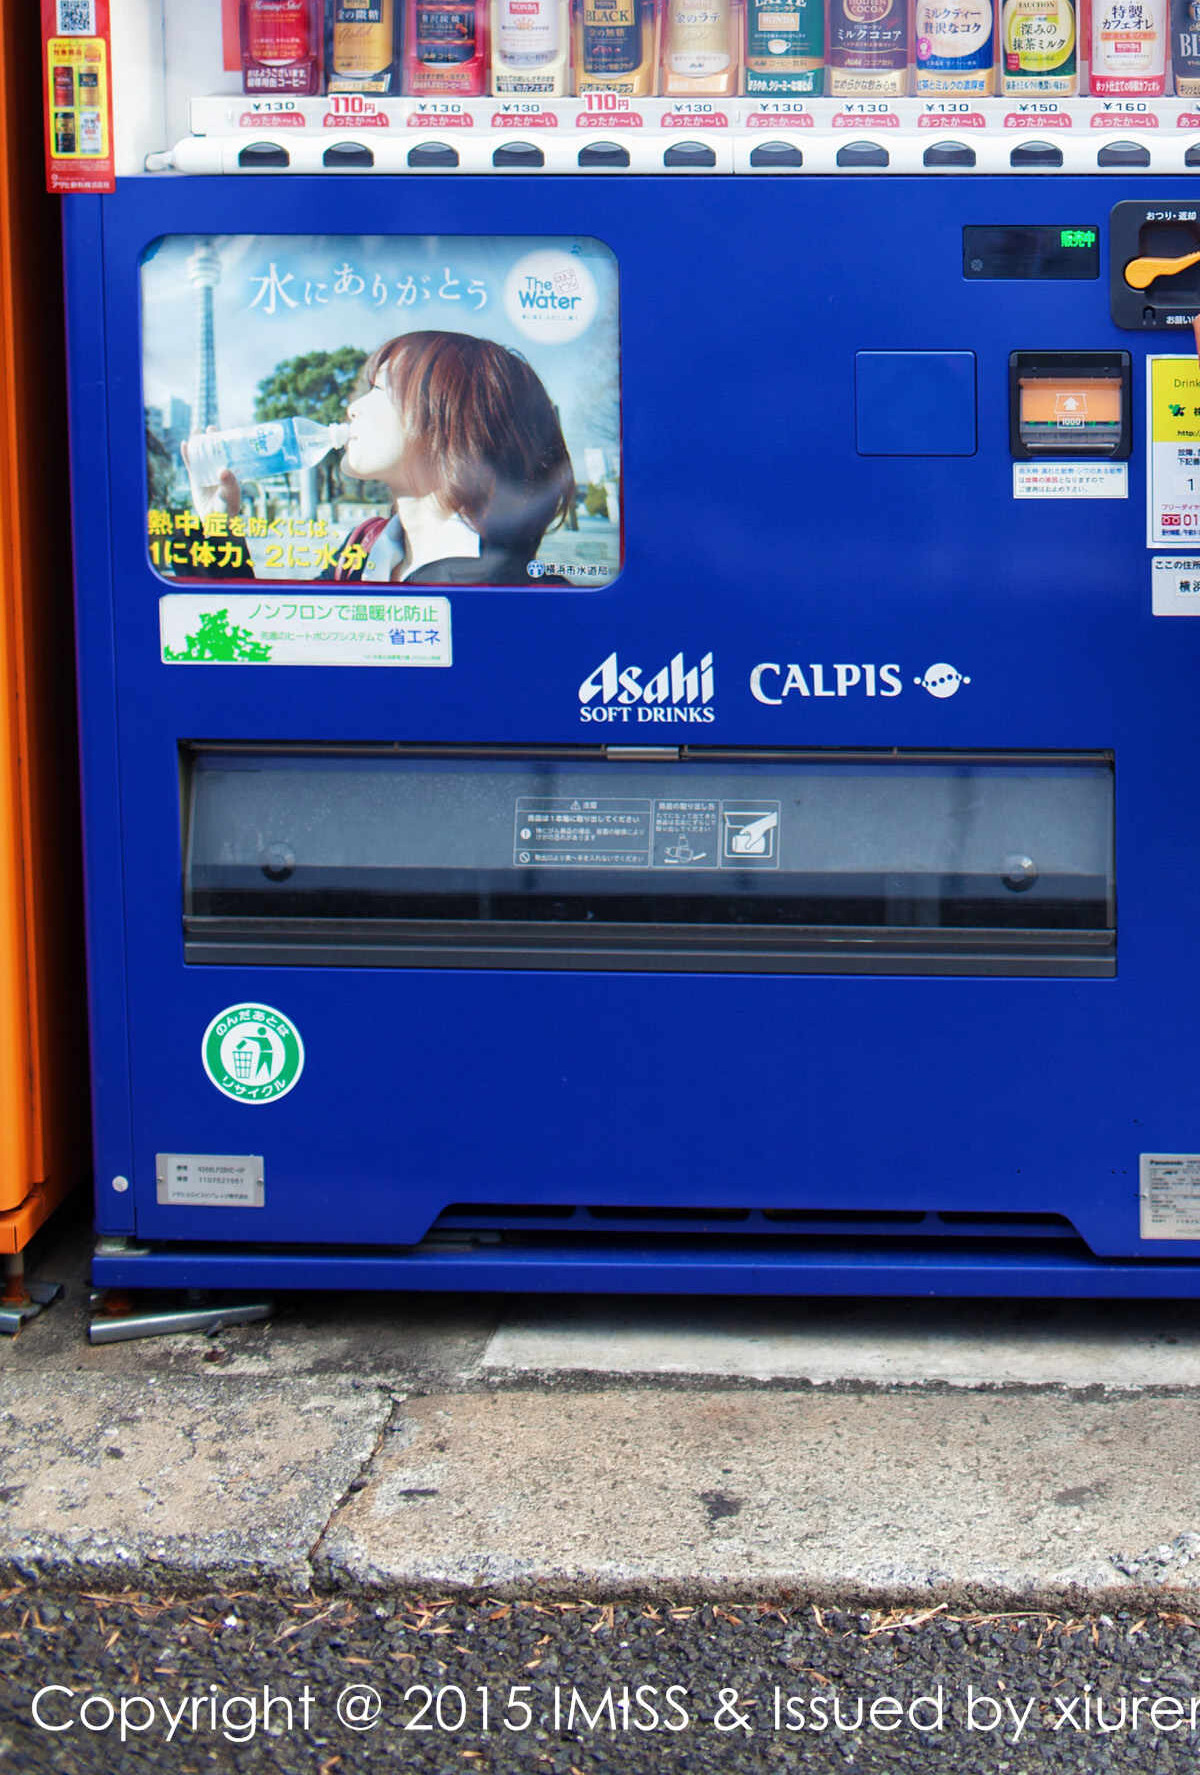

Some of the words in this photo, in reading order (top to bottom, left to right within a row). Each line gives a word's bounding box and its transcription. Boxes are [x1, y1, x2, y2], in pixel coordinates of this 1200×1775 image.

[586, 10, 630, 23] BLACK
[923, 6, 981, 20] ミルクティー
[1111, 4, 1144, 20] 特製
[836, 27, 902, 41] ミルクココア
[1019, 23, 1058, 35] 深みの
[1102, 19, 1154, 32] カフェオレ
[1012, 38, 1066, 51] 抹茶ミルク
[252, 101, 296, 111] ¥130
[330, 95, 377, 113] 110円
[584, 93, 630, 111] 110円
[925, 102, 970, 112] ¥130
[1019, 102, 1058, 112] ¥150
[1059, 230, 1096, 248] 販売中
[249, 261, 489, 316] 水にありがとう
[524, 276, 552, 292] The
[517, 289, 583, 311] Water
[1173, 378, 1200, 389] Drink
[147, 509, 341, 540] 熱中症を防ぐには、
[150, 539, 379, 573] 1に体力、2に水分。
[248, 602, 440, 624] ノンフロンで温暖化防止
[388, 627, 441, 645] 省エネ
[578, 651, 715, 706] Asahi
[749, 662, 903, 706] CALPIS
[579, 706, 632, 724] SOFT
[637, 706, 716, 724] DRINKS
[215, 1009, 290, 1038] のんだあとは
[221, 1074, 287, 1099] リサイクル
